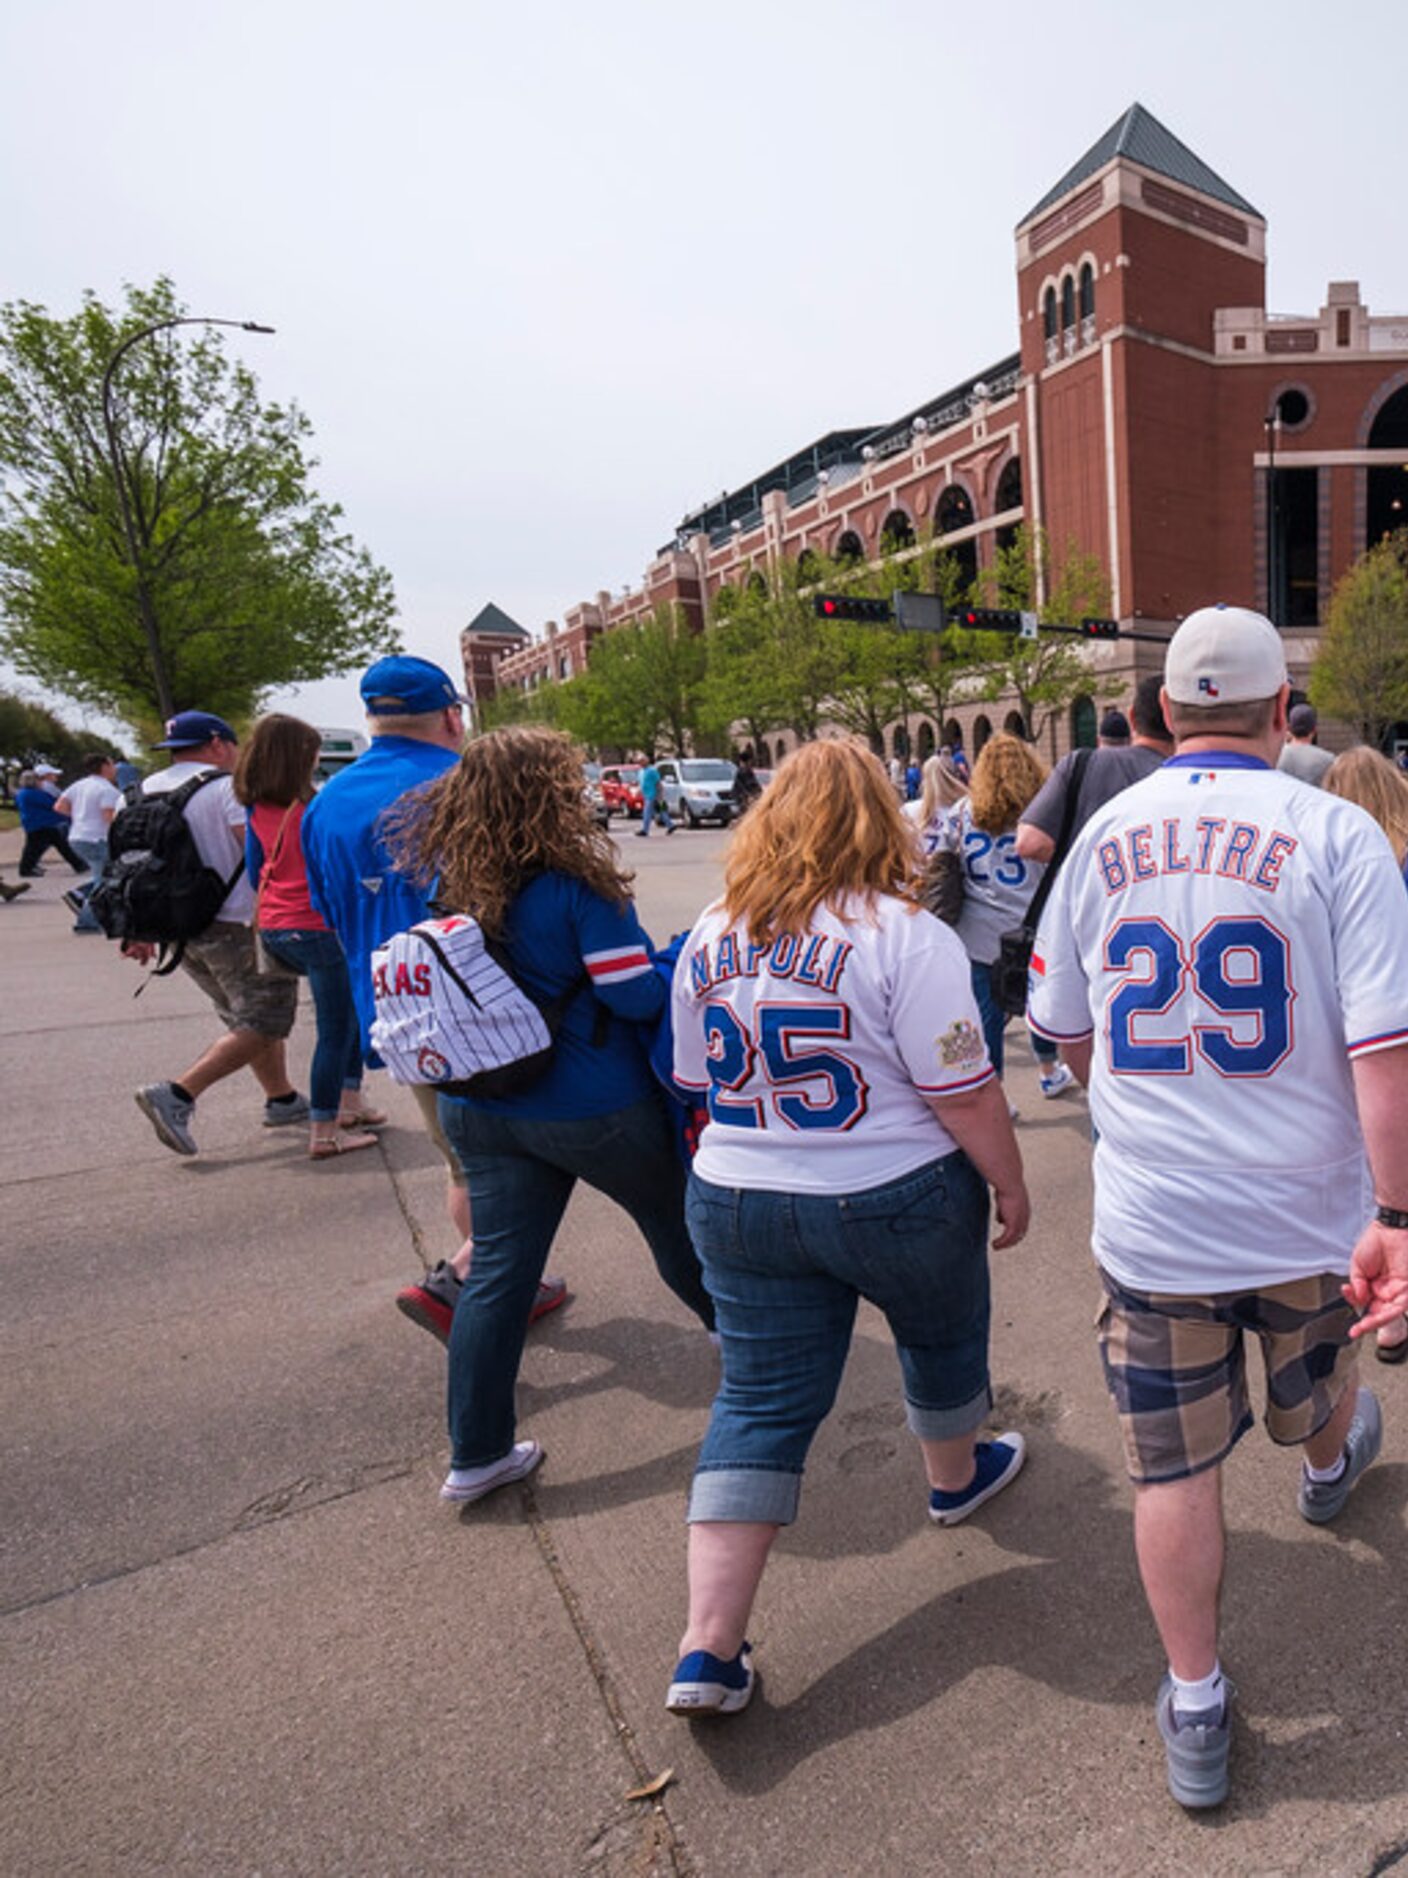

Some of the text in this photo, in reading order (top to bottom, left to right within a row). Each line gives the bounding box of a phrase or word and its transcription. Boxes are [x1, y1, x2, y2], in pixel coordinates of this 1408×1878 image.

[964, 831, 1027, 887] 23
[1096, 817, 1298, 897] BELTRE
[689, 931, 853, 999] NAPOLI
[1102, 915, 1298, 1078] 29
[702, 999, 870, 1133] 25
